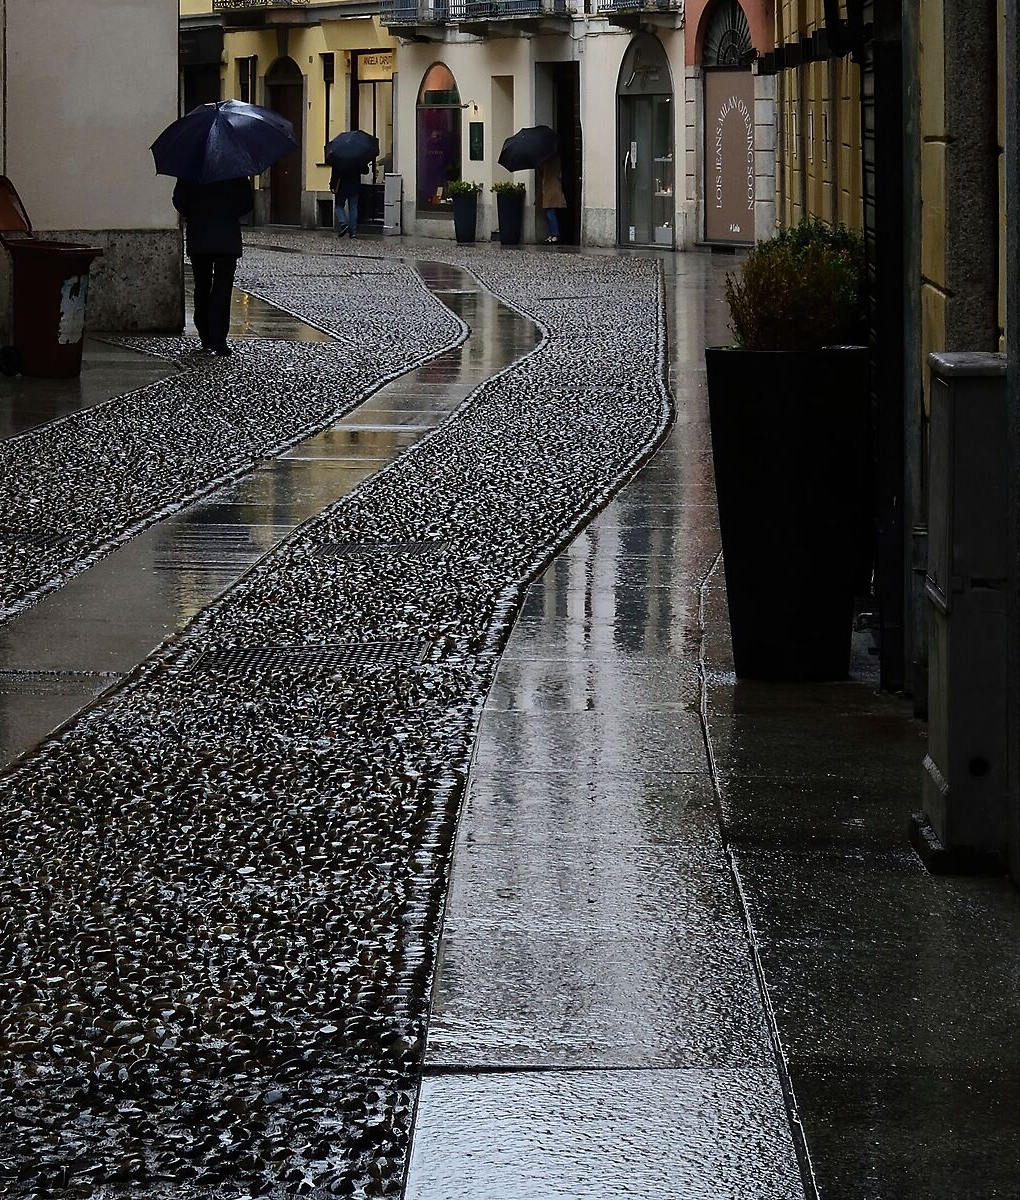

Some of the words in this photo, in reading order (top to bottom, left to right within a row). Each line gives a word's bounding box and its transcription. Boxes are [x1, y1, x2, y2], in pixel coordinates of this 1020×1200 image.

[718, 96, 738, 126] MILAN
[737, 99, 754, 163] OPENING
[746, 166, 754, 210] SOON
